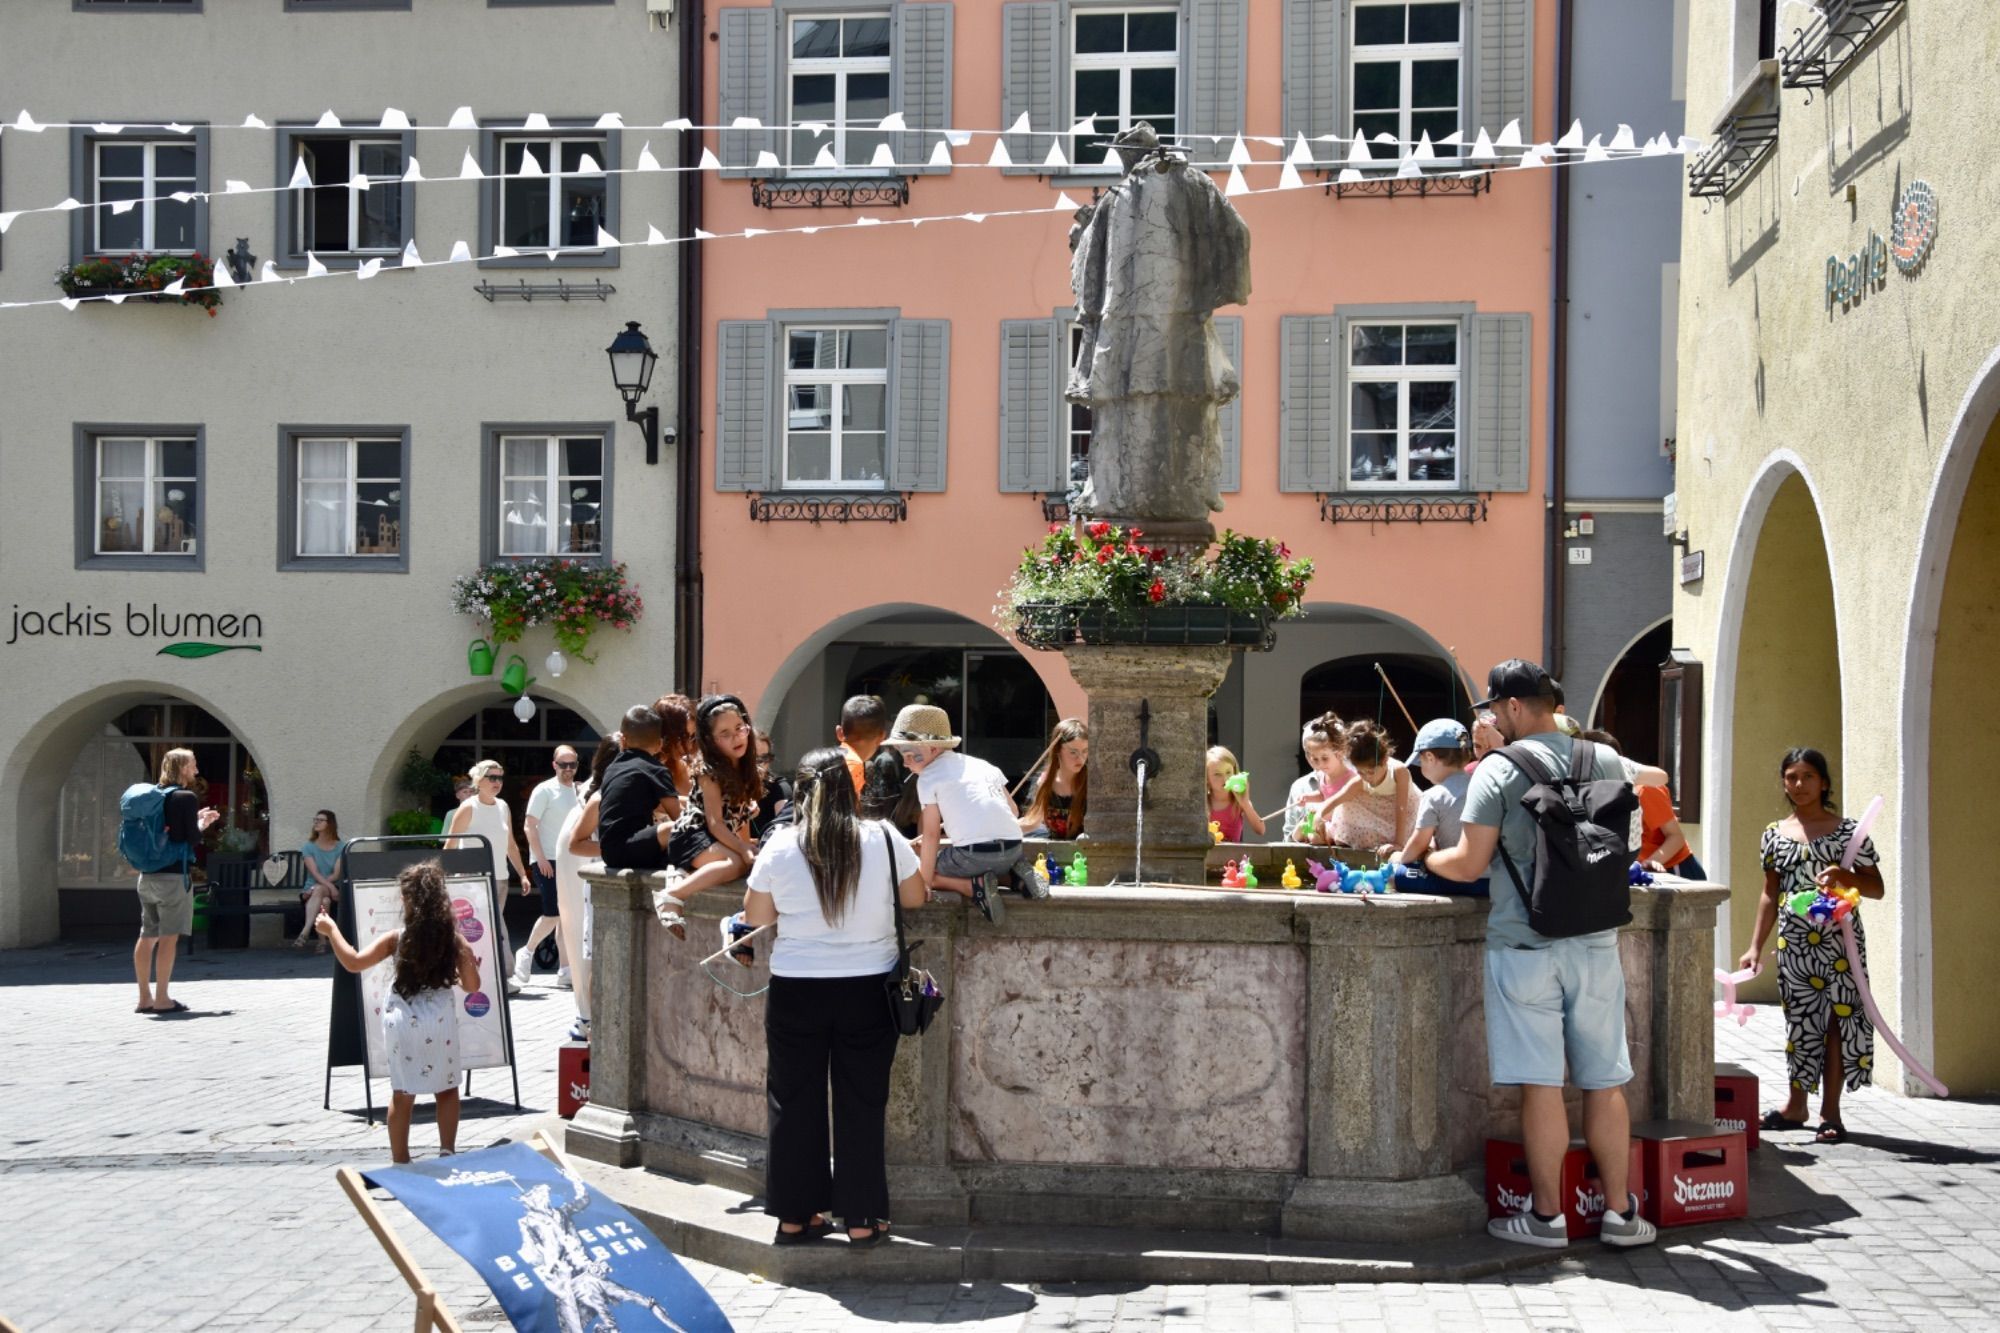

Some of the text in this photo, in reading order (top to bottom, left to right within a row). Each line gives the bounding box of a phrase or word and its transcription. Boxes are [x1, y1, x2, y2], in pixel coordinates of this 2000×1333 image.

[1824, 226, 1885, 312] Pearle
[1573, 549, 1586, 560] 31
[6, 602, 262, 644] jackis blumen
